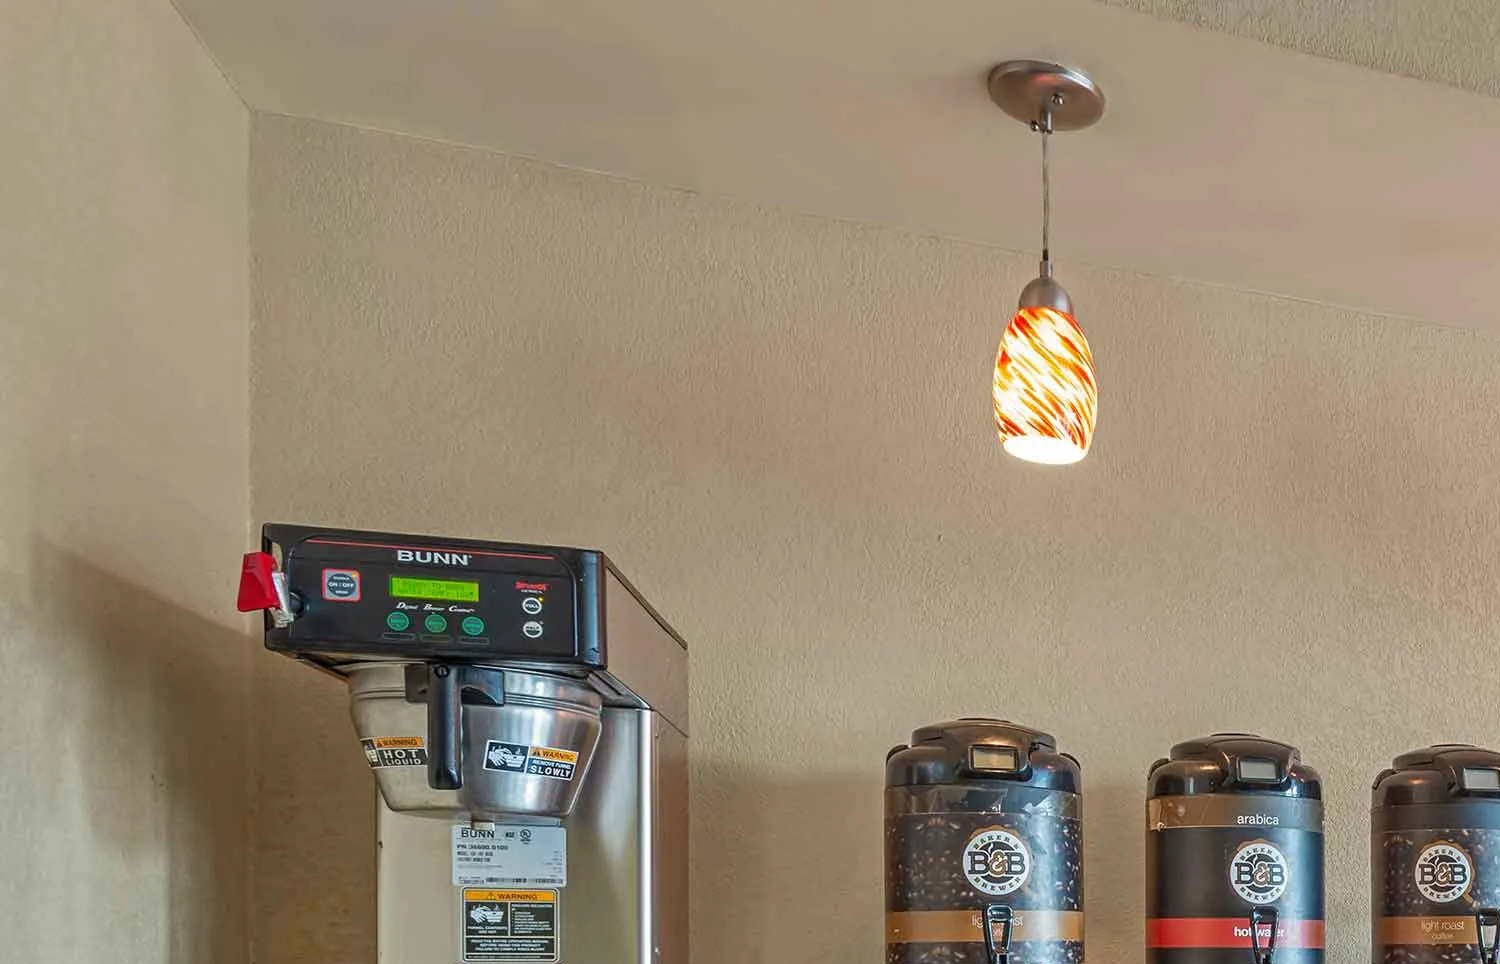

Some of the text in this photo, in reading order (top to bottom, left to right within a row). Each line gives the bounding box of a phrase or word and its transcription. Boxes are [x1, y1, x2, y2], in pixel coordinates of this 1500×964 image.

[397, 550, 469, 566] BUNN
[383, 749, 418, 759] HOT
[542, 749, 574, 761] WARNING
[385, 758, 422, 766] LIQUID
[530, 765, 571, 778] SLOWLY
[1237, 814, 1280, 825] arabica
[461, 828, 495, 839] BUNN
[967, 850, 1026, 876] B&B
[1234, 861, 1285, 886] B&B
[1418, 863, 1468, 885] B&B
[1421, 920, 1464, 932] light roast
